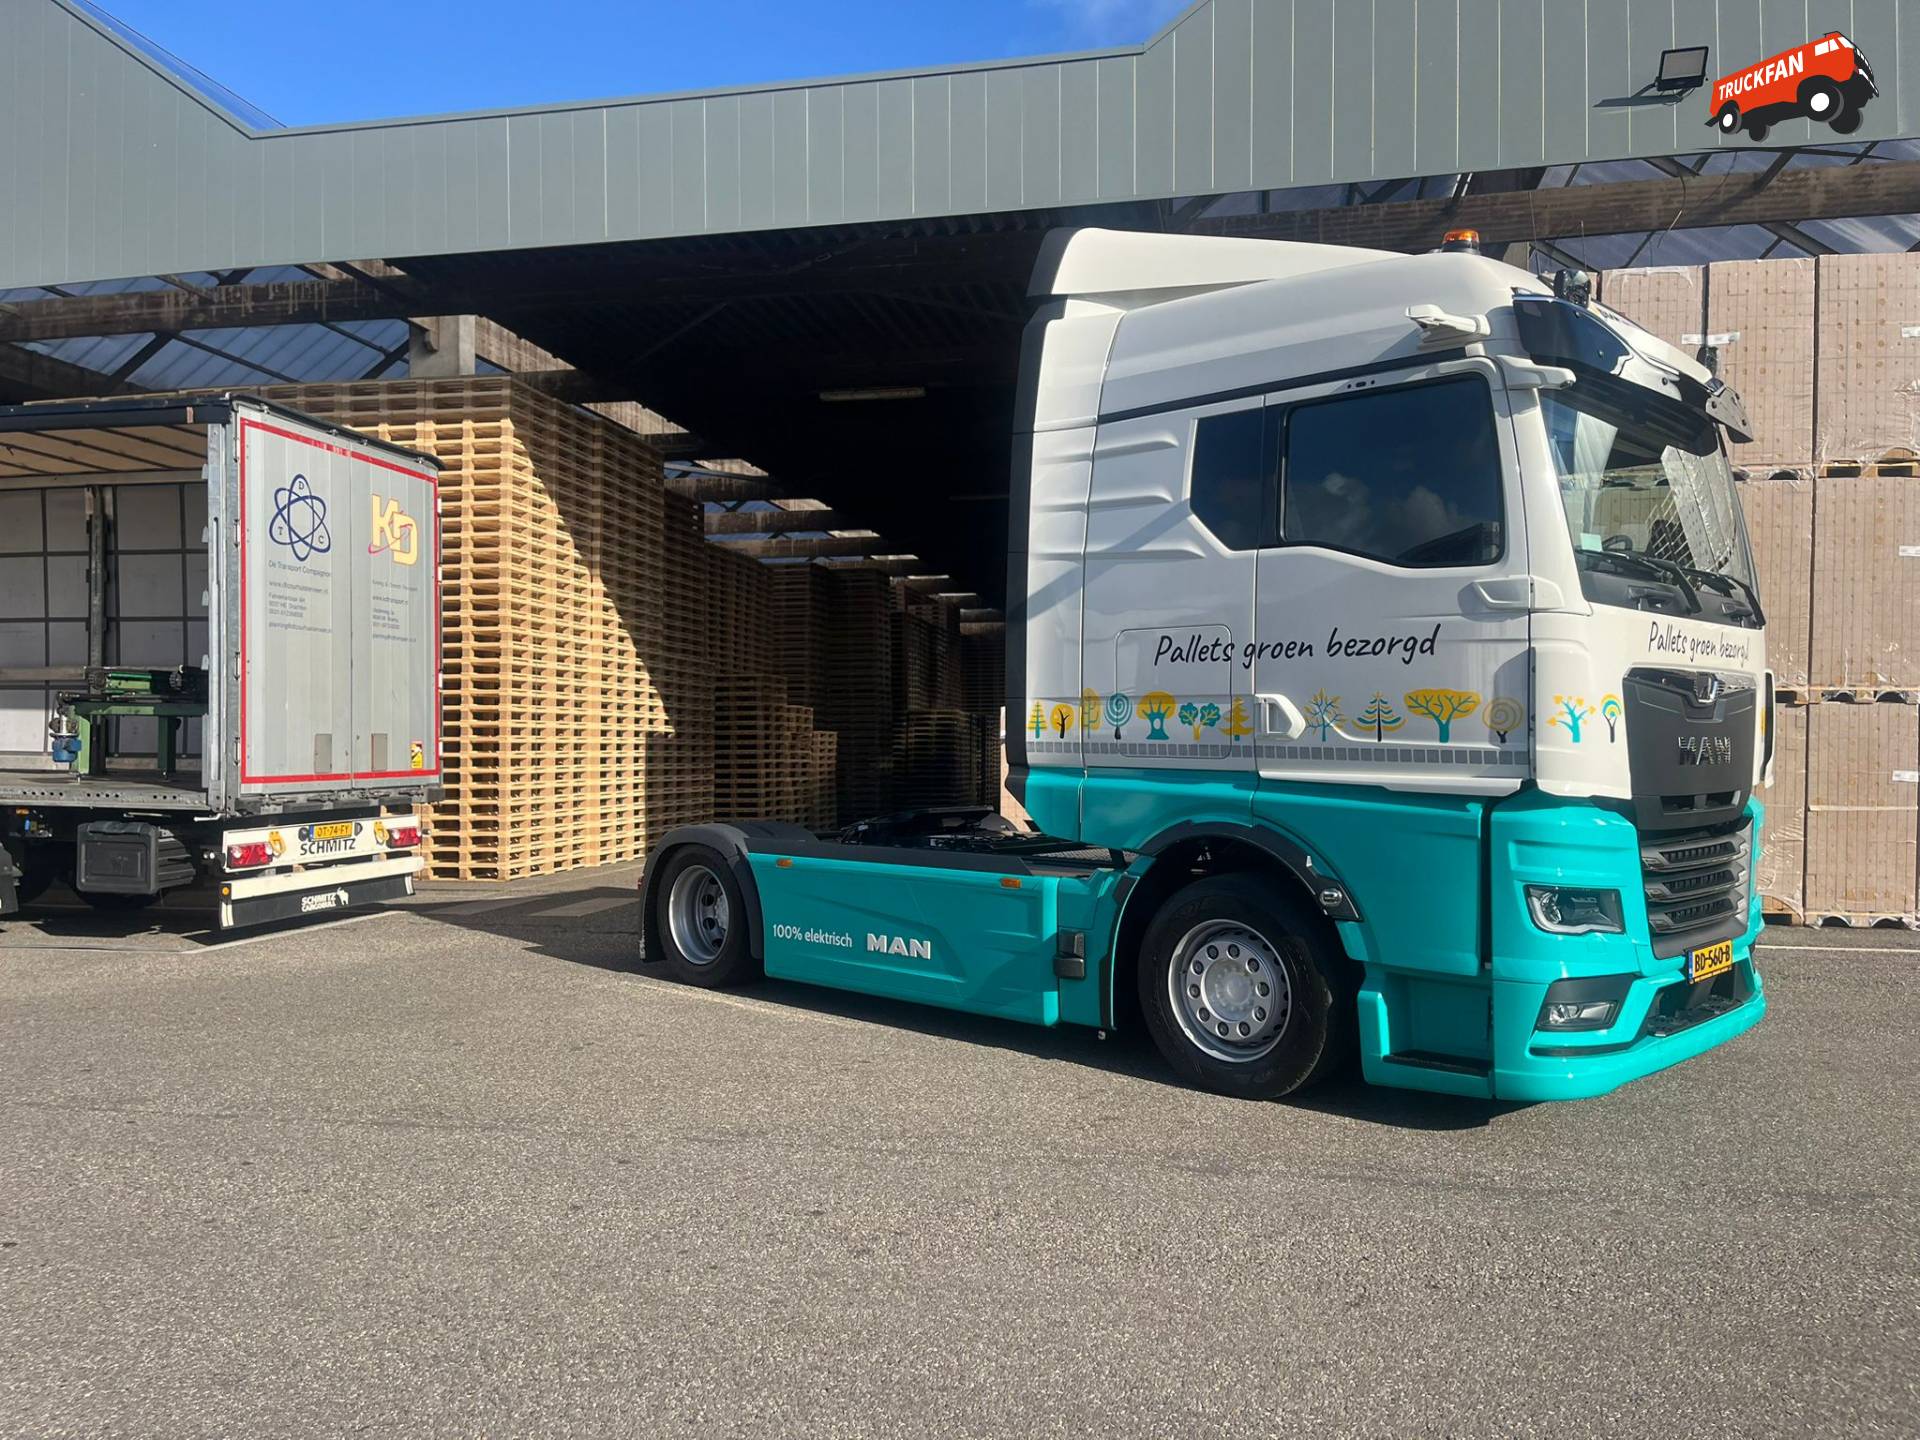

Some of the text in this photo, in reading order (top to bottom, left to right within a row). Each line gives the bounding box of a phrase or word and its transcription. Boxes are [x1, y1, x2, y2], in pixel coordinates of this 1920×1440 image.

[1154, 623, 1442, 670] Pallets groen bezorgd
[1648, 621, 1688, 654] Pallets
[1689, 637, 1717, 663] groen
[1677, 736, 1731, 766] MAN
[300, 838, 357, 856] SCHMITZ
[772, 924, 853, 948] 100% elektrisch
[866, 933, 931, 960] MAN
[1694, 944, 1731, 973] BD-560-B
